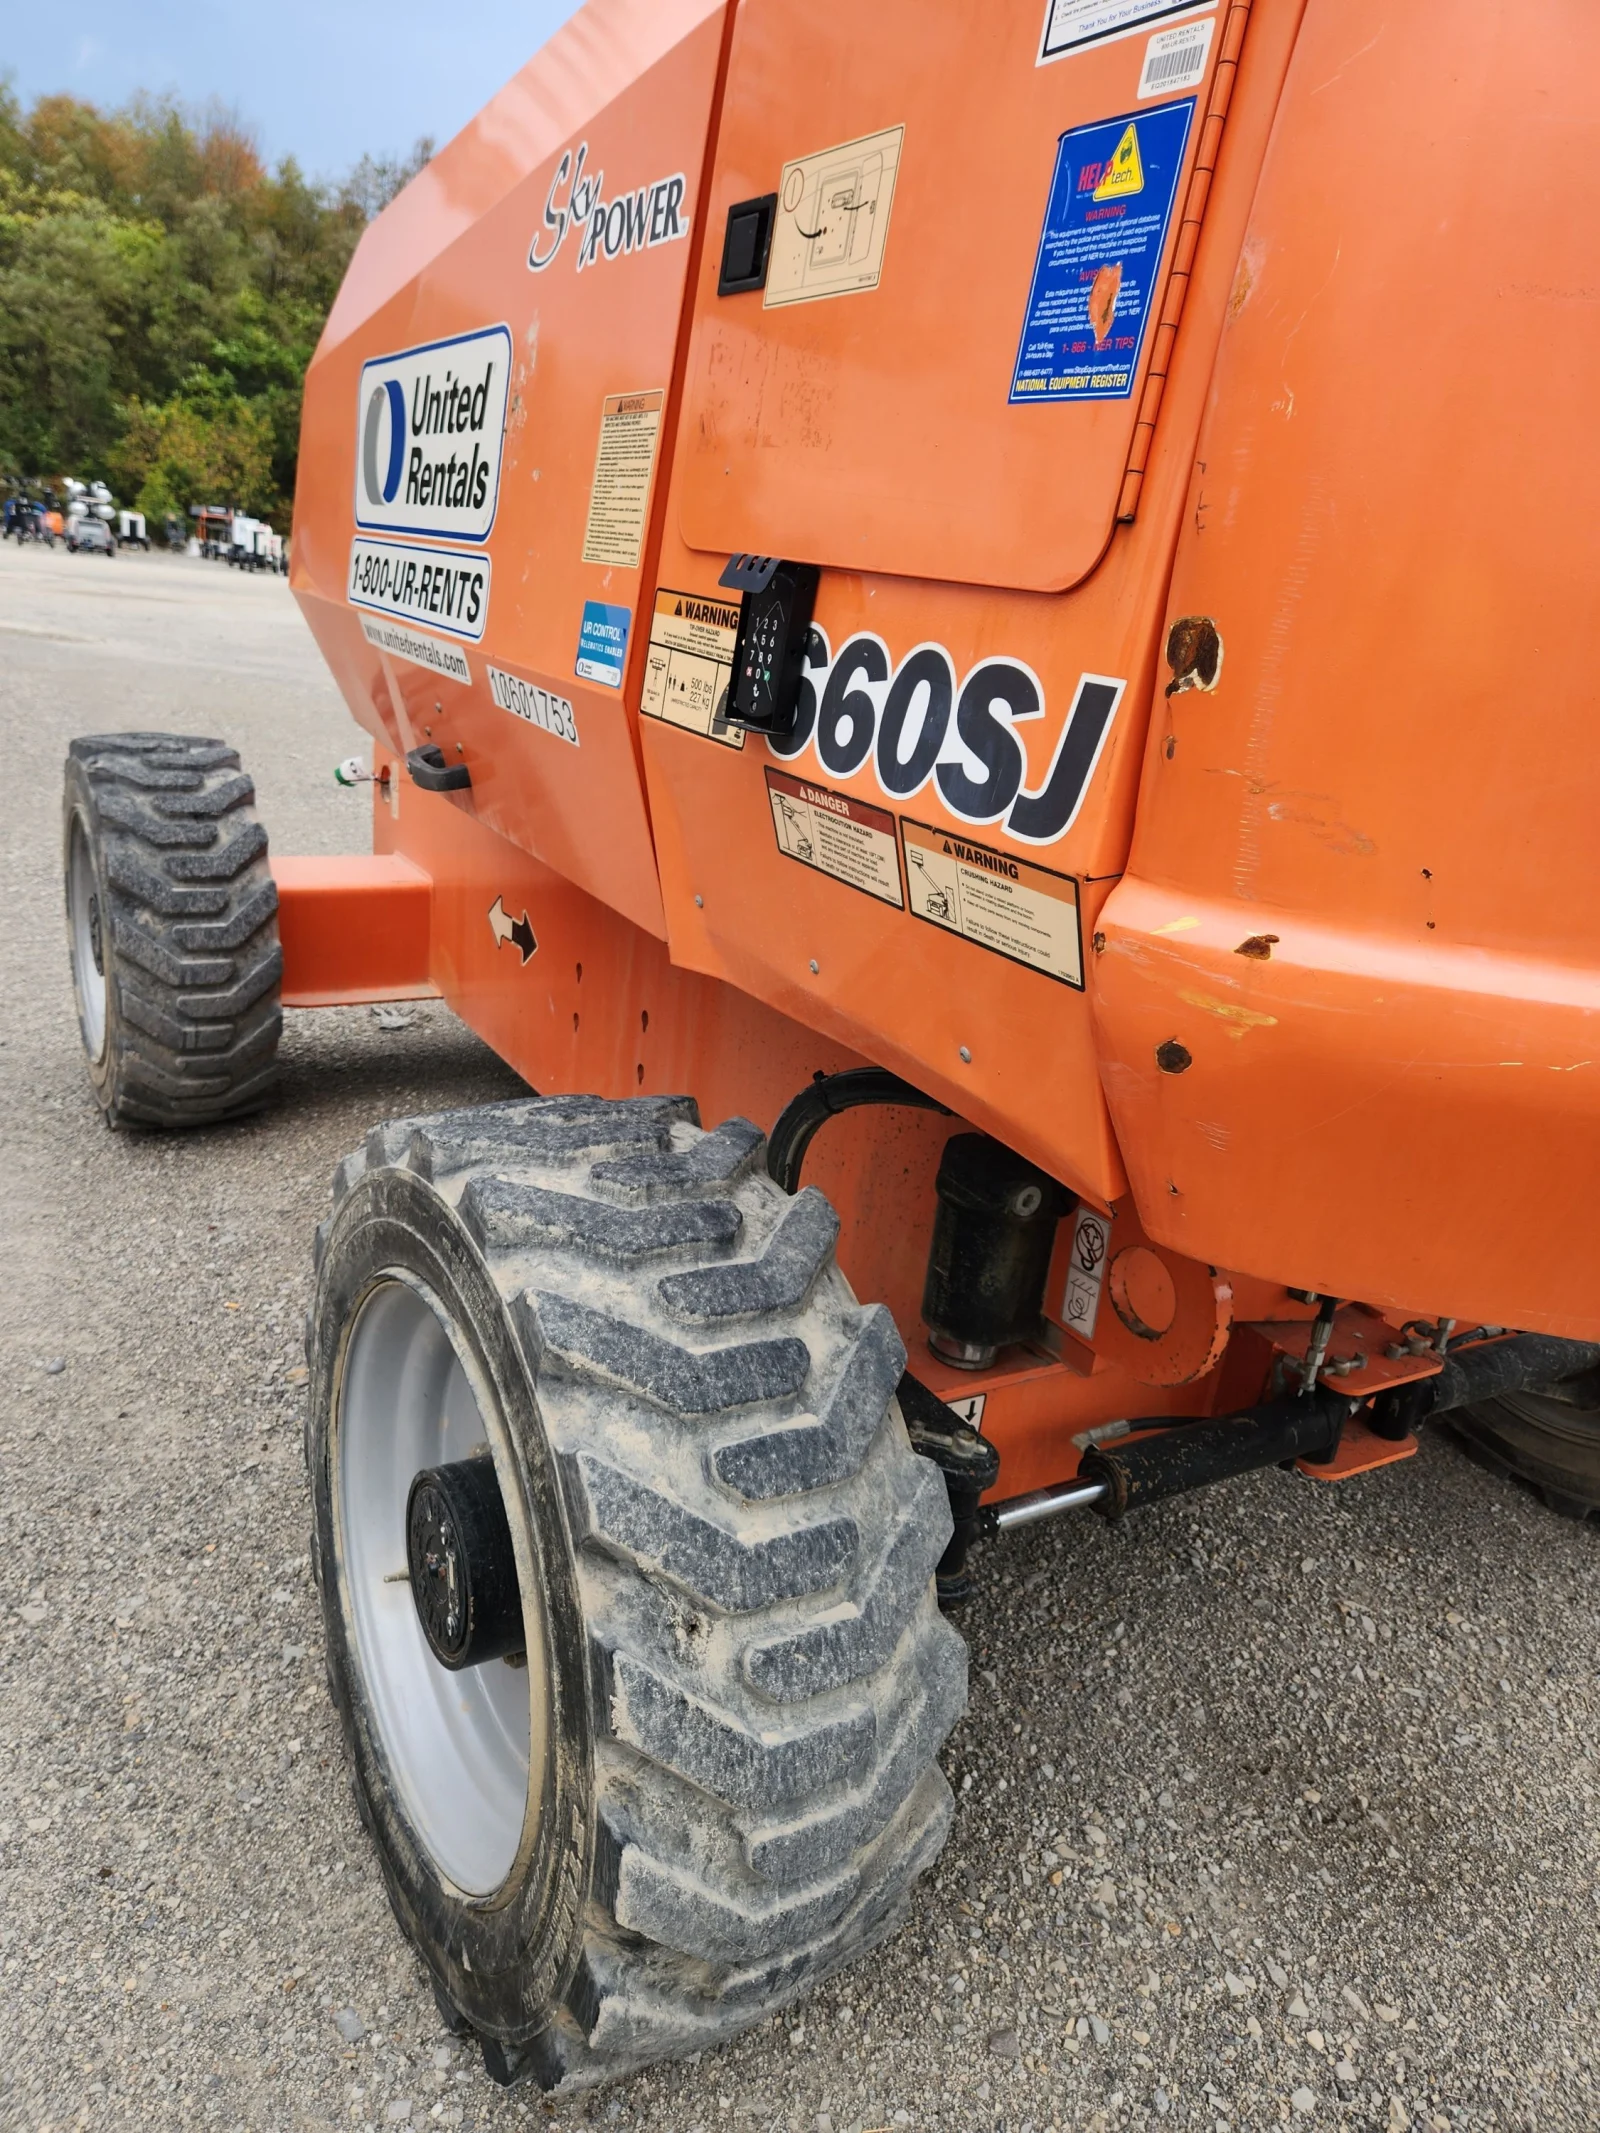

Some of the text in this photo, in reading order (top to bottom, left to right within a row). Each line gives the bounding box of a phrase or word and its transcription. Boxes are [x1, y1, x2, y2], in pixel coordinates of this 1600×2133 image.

[1079, 20, 1095, 33] Thank
[1096, 16, 1107, 26] You
[1109, 13, 1117, 23] for
[1118, 9, 1132, 20] Your
[1178, 24, 1205, 37] RENTALS
[529, 146, 603, 269] Sky
[1084, 203, 1127, 222] WARNING
[588, 178, 683, 260] POWER
[1058, 228, 1081, 239] equipment
[1122, 228, 1133, 237] used
[1113, 336, 1135, 349] TIPS
[1015, 372, 1128, 392] NATIONAL EQUIPMENT REGISTER
[412, 362, 493, 436] United
[406, 443, 489, 509] Rentals
[352, 554, 483, 623] 1-800-UR-RENTS
[684, 599, 738, 630] WARNING
[764, 618, 769, 629] 2
[772, 620, 778, 631] 3
[582, 620, 622, 641] UR CONTROL
[761, 634, 767, 646] 5
[769, 636, 775, 648] 6
[365, 624, 467, 677] www.unitedrentals.com
[579, 638, 623, 657] TELEMATICS ENABLED
[749, 650, 773, 665] 7 8 9
[755, 668, 761, 680] 0
[690, 677, 712, 694] 500 lbs
[492, 671, 576, 742] 10601753
[689, 690, 710, 709] 227 kg
[806, 787, 849, 816] DANGER
[813, 809, 872, 839] ELECTROCUTION HAZARD
[825, 824, 838, 834] machine
[819, 851, 832, 861] Failure
[836, 859, 847, 869] follow
[847, 864, 870, 879] instructions
[877, 877, 889, 887] result
[953, 842, 1018, 880] WARNING
[840, 868, 853, 879] serious
[960, 867, 1012, 894] CRUSHING HAZARD
[965, 917, 979, 928] Failure
[985, 925, 997, 935] follow
[998, 930, 1009, 941] these
[1010, 936, 1036, 952] instructions
[1036, 947, 1050, 958] could
[966, 924, 977, 934] result
[983, 932, 995, 942] death
[1001, 939, 1016, 952] serious
